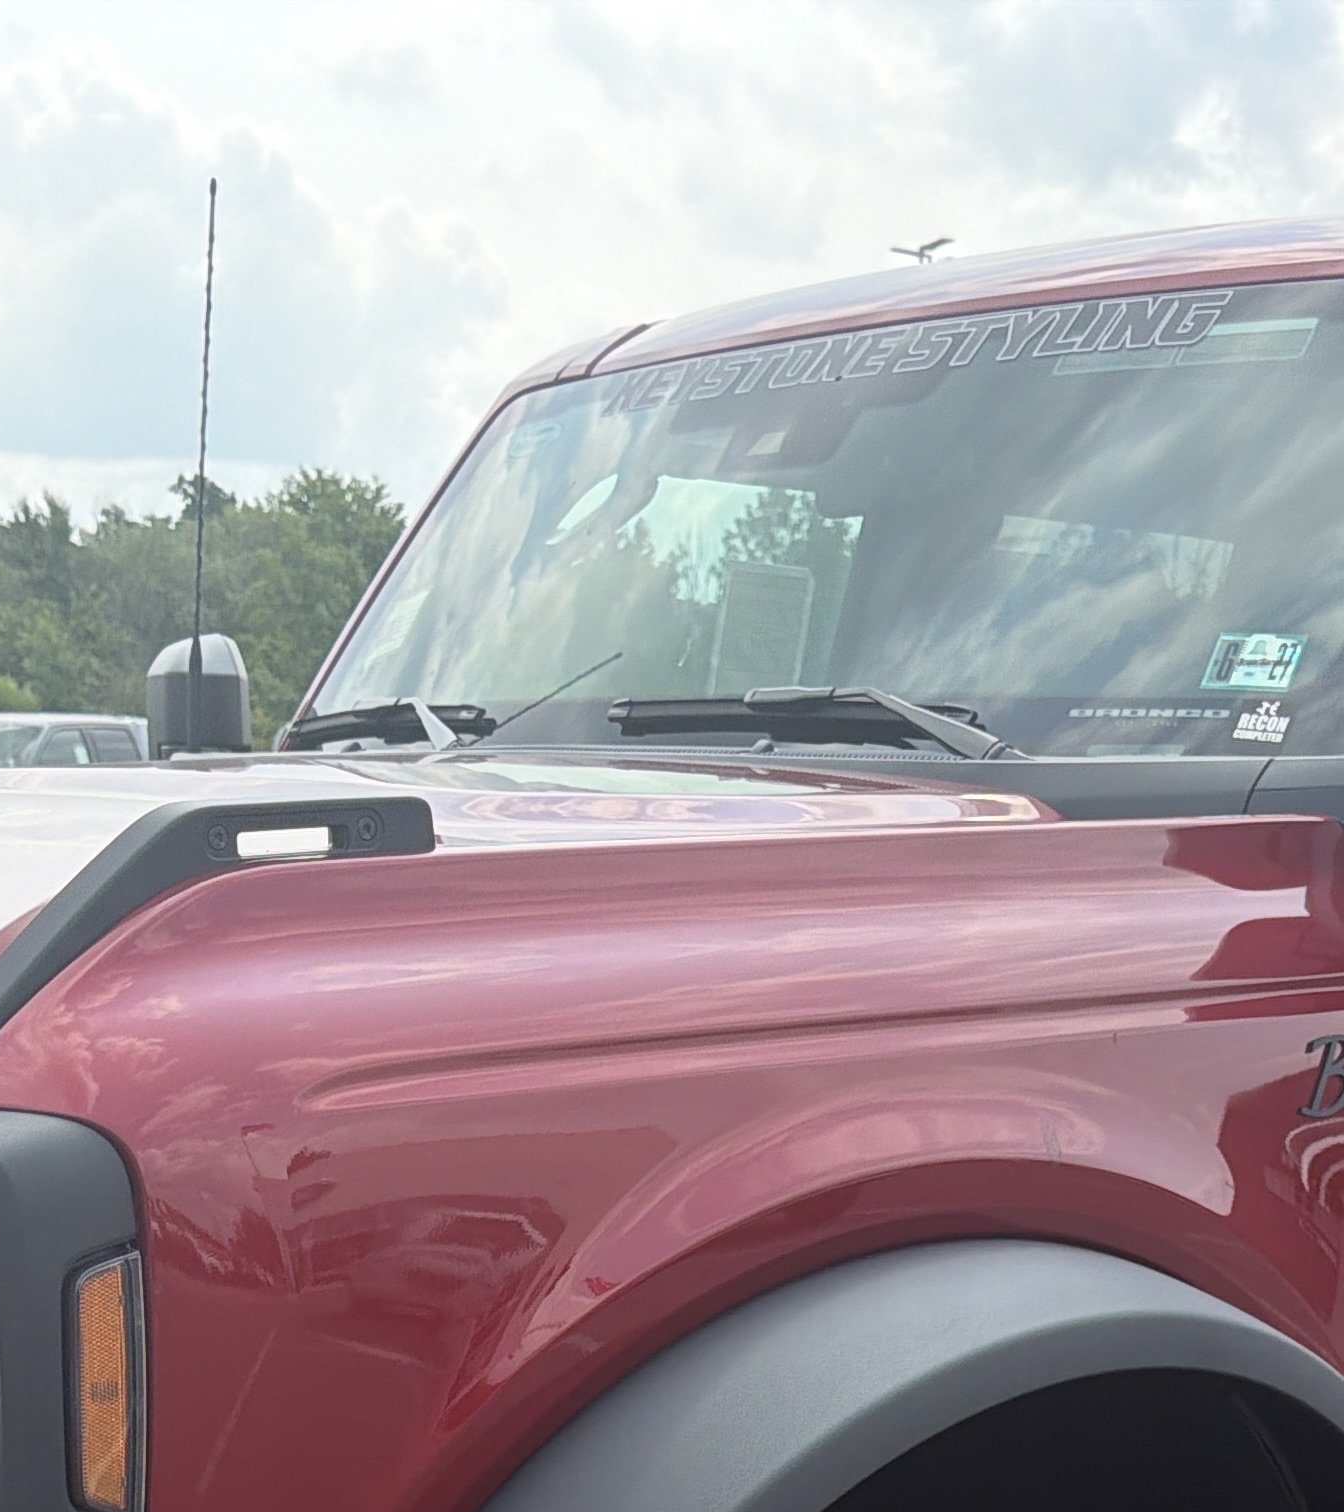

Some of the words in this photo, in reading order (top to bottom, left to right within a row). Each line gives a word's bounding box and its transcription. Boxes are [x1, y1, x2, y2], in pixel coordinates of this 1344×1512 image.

[602, 330, 902, 417] KEYSTONE
[892, 292, 1233, 373] STYLING
[1216, 641, 1240, 681] 6
[1267, 642, 1299, 681] 27
[1068, 708, 1231, 719] BRONCO
[1237, 712, 1291, 734] RECON
